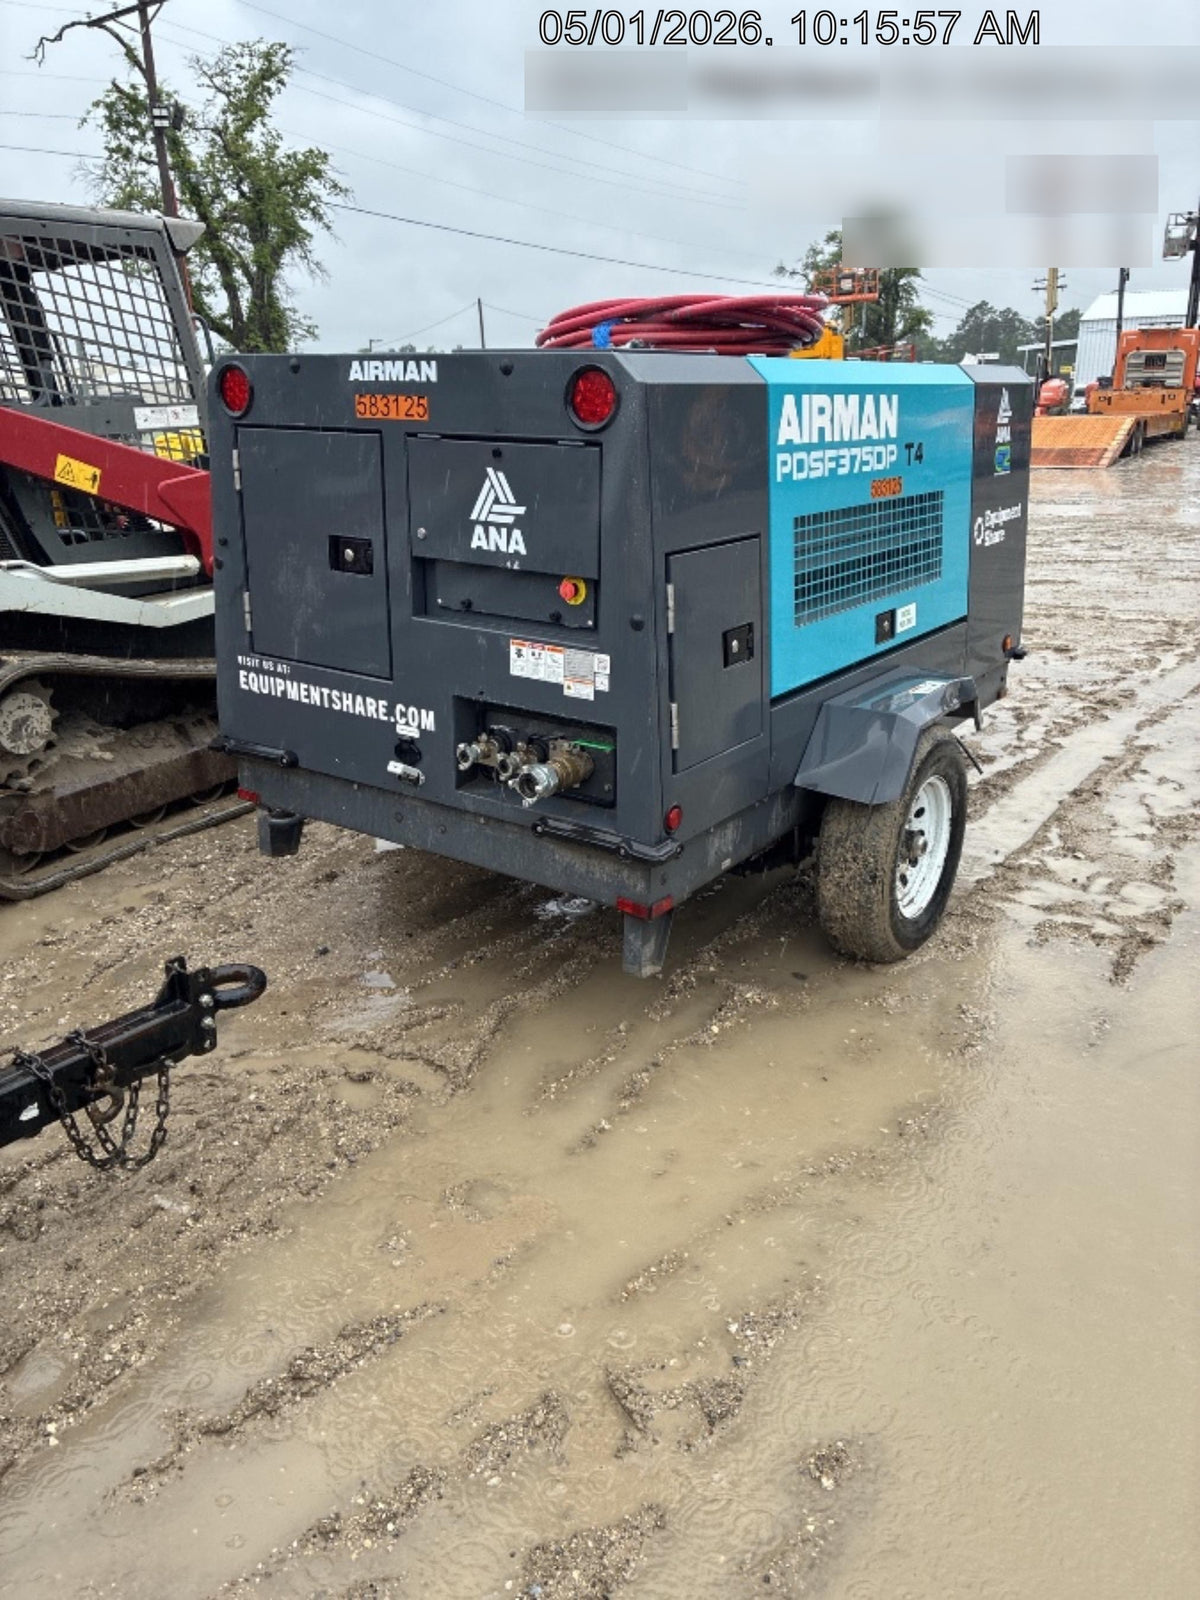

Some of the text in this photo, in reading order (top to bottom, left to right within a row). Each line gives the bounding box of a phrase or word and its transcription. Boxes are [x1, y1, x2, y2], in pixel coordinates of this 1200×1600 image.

[348, 360, 438, 383] AIRMAN
[356, 393, 428, 418] 583125
[776, 393, 899, 446] AIRMAN
[776, 442, 924, 482] PDSF375DP T4
[470, 524, 527, 555] ANA
[237, 655, 260, 668] VISIT
[262, 660, 275, 671] US
[239, 669, 436, 732] EQUIPMENTSHARE.COM
